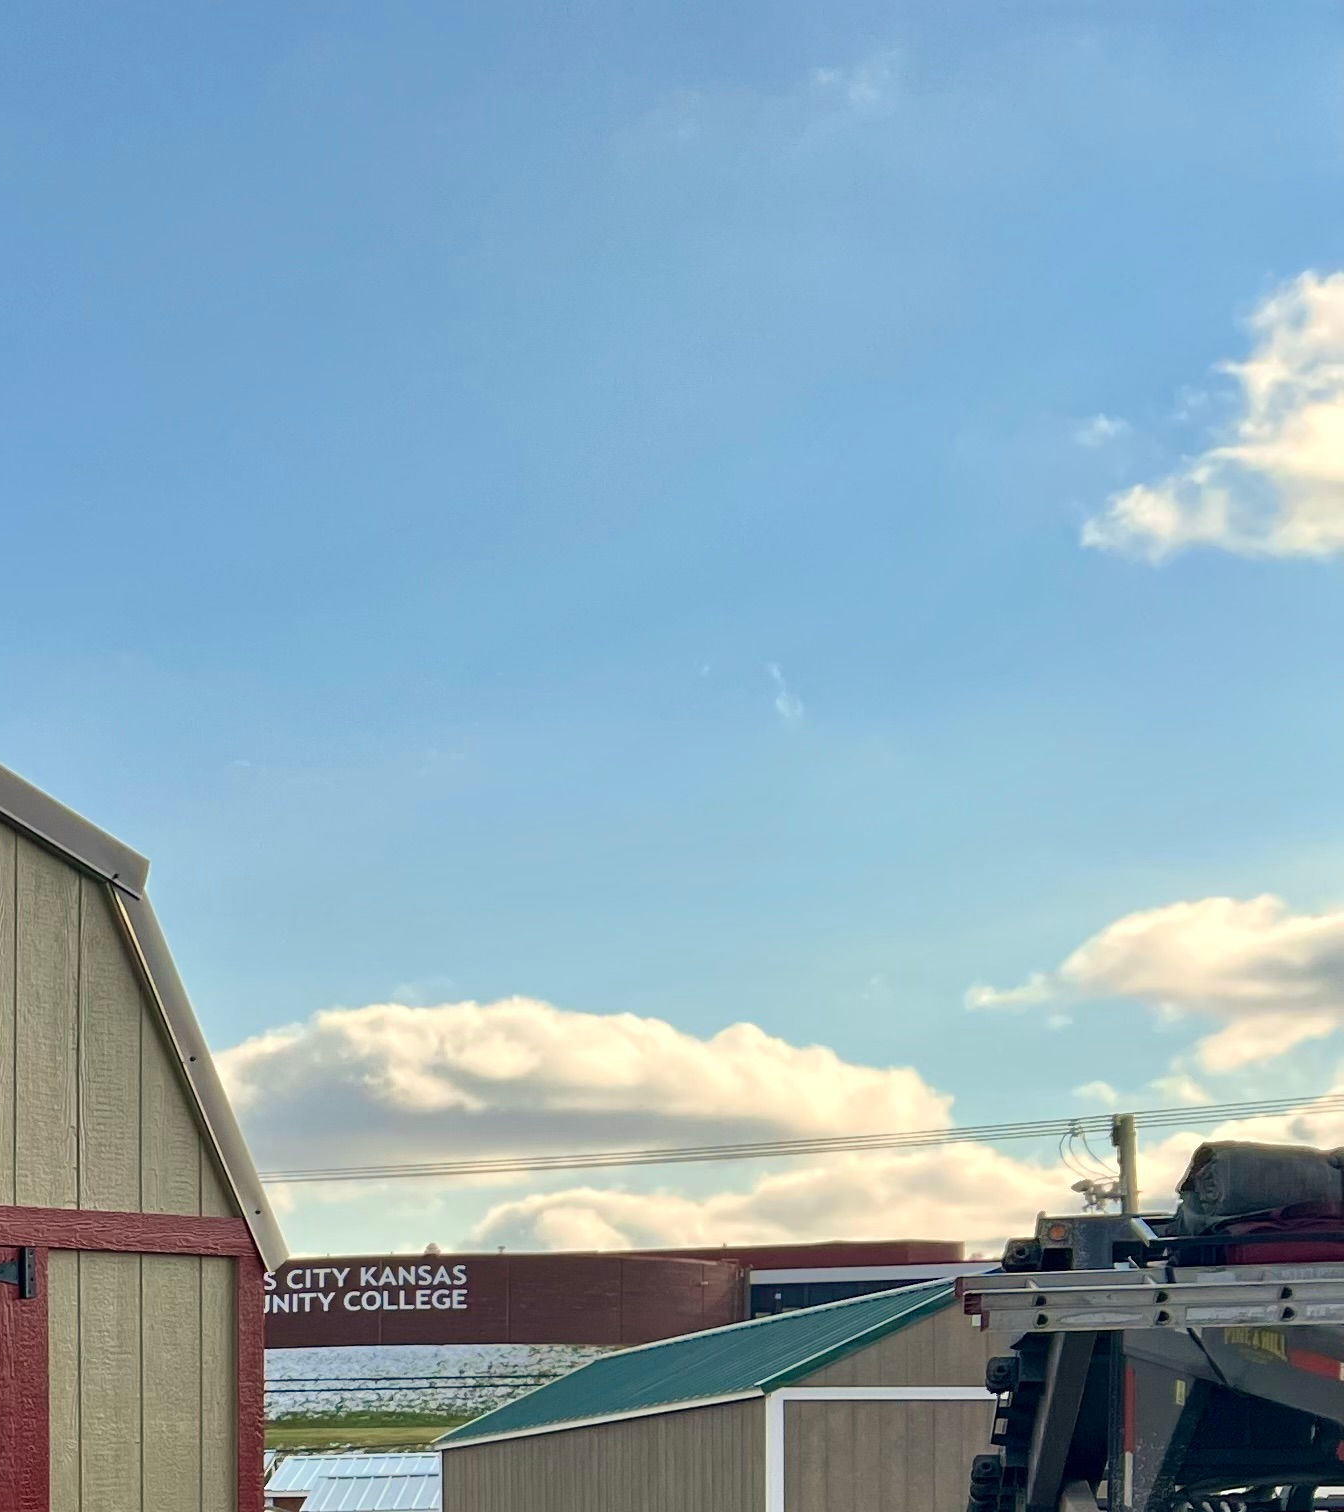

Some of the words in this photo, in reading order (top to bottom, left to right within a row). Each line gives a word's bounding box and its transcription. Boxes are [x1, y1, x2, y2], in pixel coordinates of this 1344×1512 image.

[286, 1267, 351, 1289] CITY
[360, 1265, 468, 1287] KANSAS
[343, 1289, 468, 1311] COLLEGE
